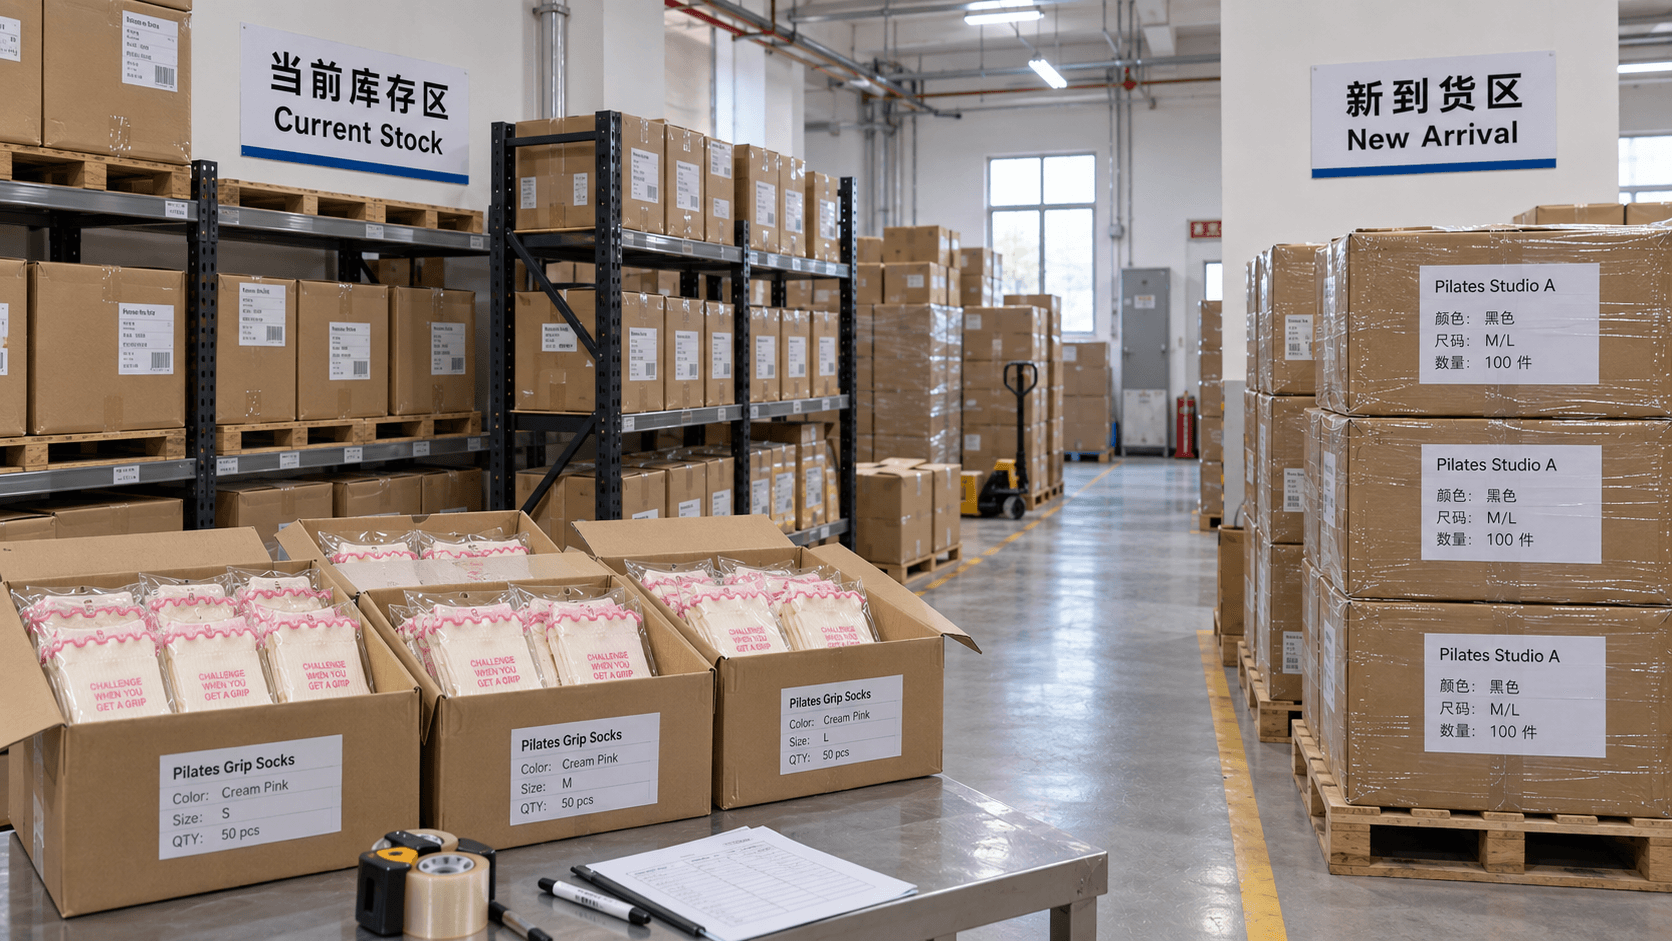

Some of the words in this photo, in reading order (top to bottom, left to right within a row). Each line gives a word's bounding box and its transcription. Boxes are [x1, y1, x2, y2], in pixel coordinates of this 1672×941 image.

[271, 51, 448, 121] 当前库存区
[1346, 73, 1522, 117] 新到货区
[274, 106, 371, 144] Current
[380, 123, 443, 155] Stock
[1348, 128, 1409, 151] New
[1421, 120, 1517, 147] Arrival
[1436, 279, 1485, 293] Pilates
[1490, 278, 1539, 292] Studio
[1544, 279, 1556, 292] A
[1485, 310, 1515, 325] 黑色
[1486, 334, 1515, 348] M/L
[1486, 356, 1511, 369] 100
[1517, 355, 1532, 369] 件
[1437, 458, 1487, 471] Pilates
[1492, 458, 1541, 471] Studio
[1545, 458, 1557, 471] A
[1487, 488, 1516, 503] 黑色
[1488, 511, 1516, 525] M/L
[1487, 533, 1513, 546] 100
[1519, 532, 1534, 547] 件
[1440, 647, 1490, 662] Pilates
[1495, 648, 1544, 662] Studio
[1549, 650, 1560, 663] A
[94, 690, 121, 701] WHEN
[123, 687, 143, 697] YOU
[1490, 680, 1519, 694] 黑色
[97, 702, 114, 712] GET
[790, 697, 821, 709] Pilates
[823, 693, 844, 708] Grip
[845, 689, 871, 704] Socks
[1491, 703, 1519, 717] M/L
[789, 718, 814, 729] Color:
[824, 715, 850, 725] Cream
[853, 710, 870, 721] Pink
[789, 736, 809, 747] Size:
[824, 733, 829, 742] L
[1491, 725, 1516, 738] 100
[1522, 725, 1537, 739] 件
[522, 738, 560, 752] Pilates
[563, 733, 586, 748] Grip
[590, 729, 622, 743] Socks
[521, 763, 551, 774] Color:
[562, 758, 594, 769] Cream
[598, 753, 618, 765] Pink
[789, 752, 810, 765] QTY:
[823, 749, 833, 760] 50
[836, 749, 849, 760] pcs
[174, 765, 220, 780] Pilates
[224, 759, 252, 774] Grip
[256, 754, 295, 769] Socks
[173, 792, 208, 804] Color:
[222, 786, 260, 798] Cream
[265, 780, 288, 792] Pink
[521, 783, 545, 794] Size:
[563, 777, 572, 788] M
[521, 801, 546, 814] QTY:
[562, 797, 575, 808] 50
[577, 797, 593, 809] pcs
[173, 814, 202, 826] Size:
[222, 807, 230, 819] S
[173, 833, 202, 847] QTY:
[222, 828, 236, 840] 50
[240, 827, 259, 840] pcs
